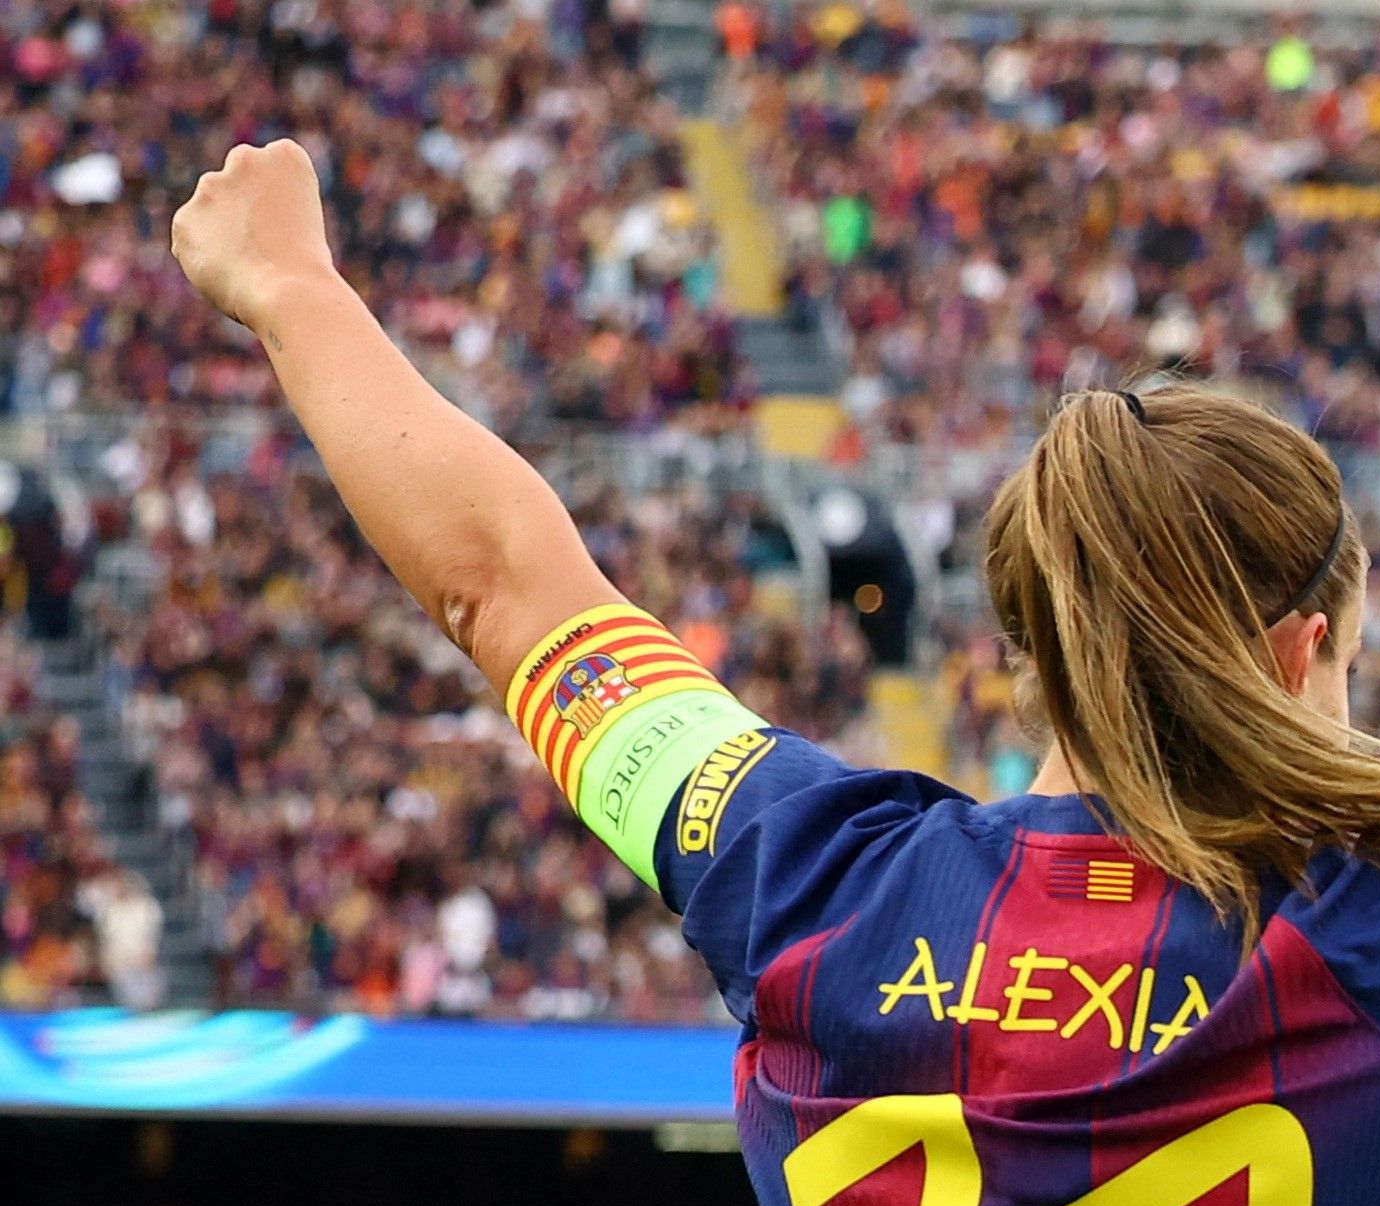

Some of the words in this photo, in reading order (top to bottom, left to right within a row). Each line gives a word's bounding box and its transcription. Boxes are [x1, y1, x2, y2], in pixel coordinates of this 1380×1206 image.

[605, 715, 684, 830] RESPECT
[682, 730, 768, 851] BIMBO
[878, 936, 1210, 1056] ALEXIA
